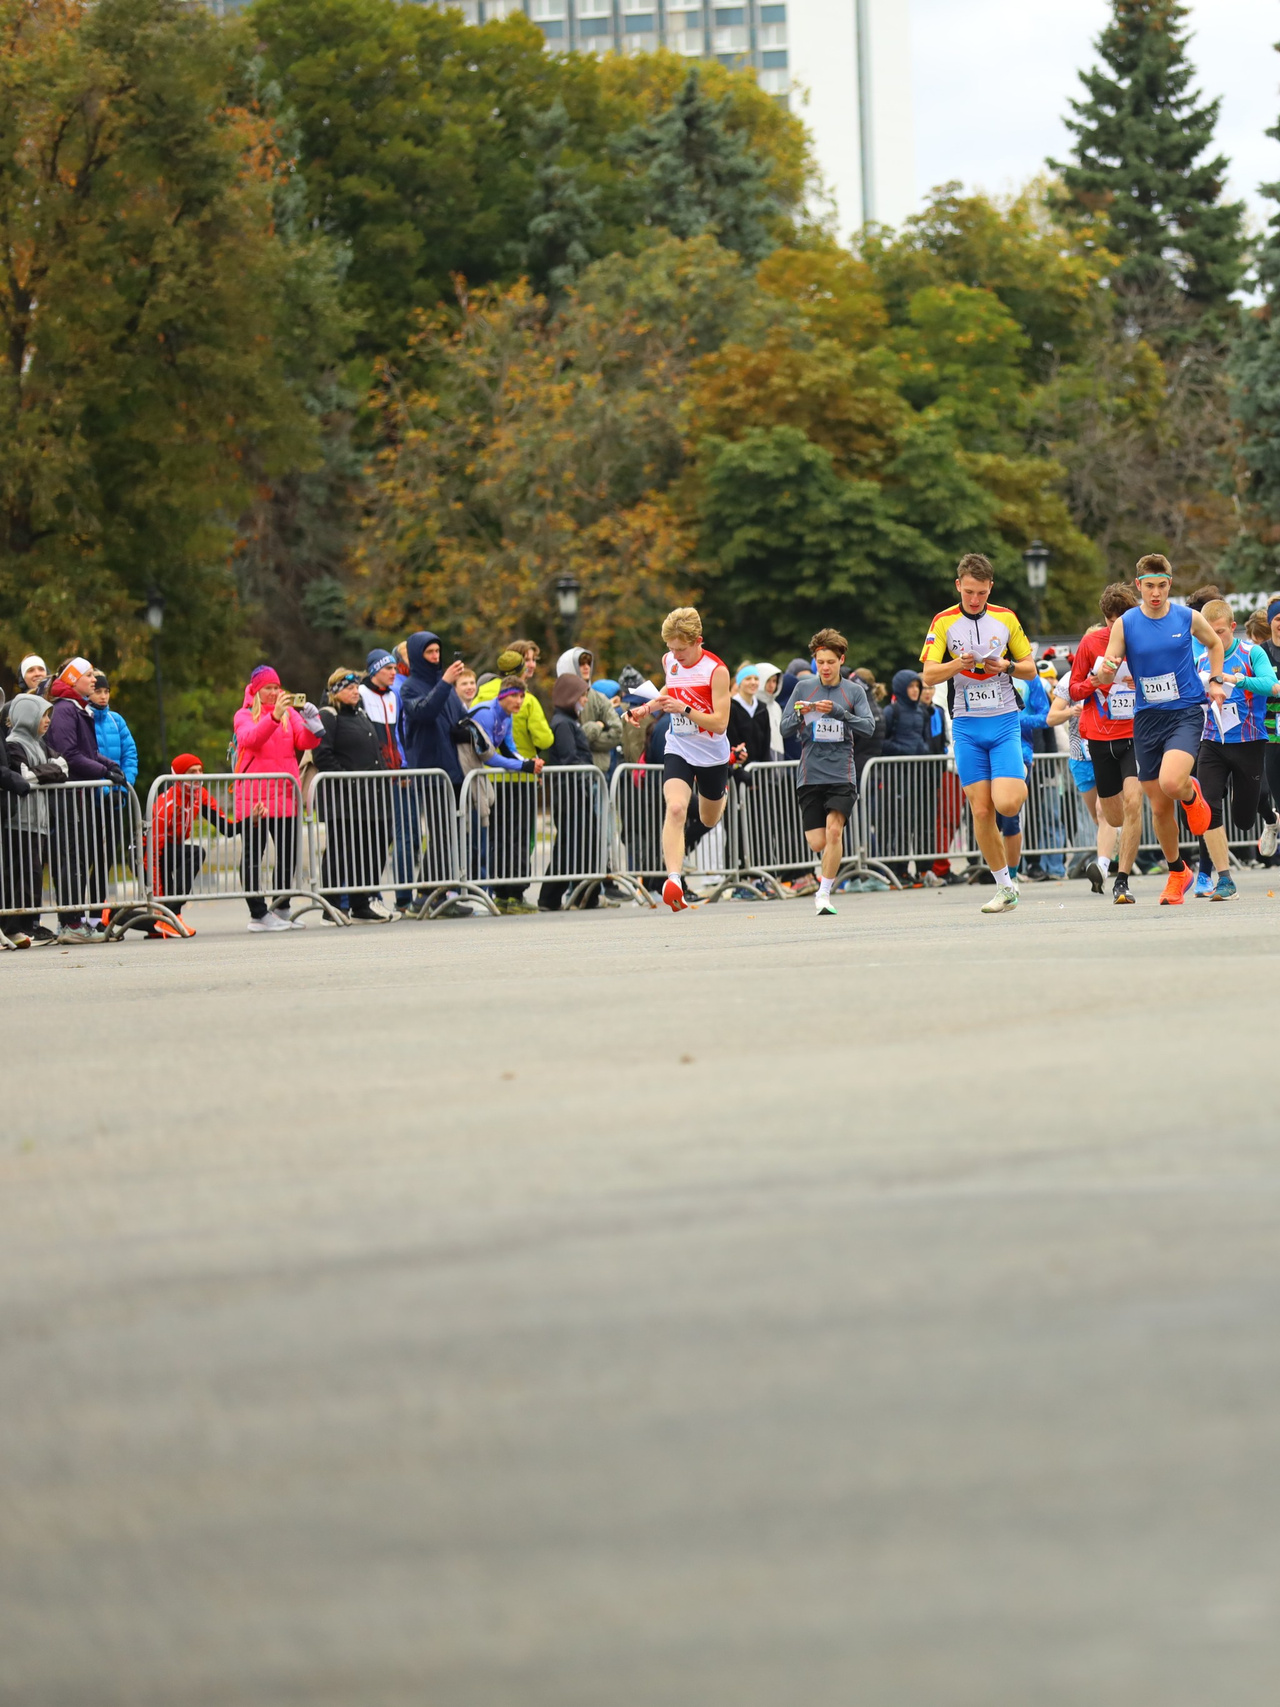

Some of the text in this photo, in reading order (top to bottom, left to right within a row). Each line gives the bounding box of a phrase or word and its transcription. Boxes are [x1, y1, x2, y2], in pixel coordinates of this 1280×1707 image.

[1144, 682, 1171, 693] 220.1
[968, 689, 996, 701] 236.1
[1111, 699, 1135, 708] 232.1
[816, 724, 839, 733] 234.1
